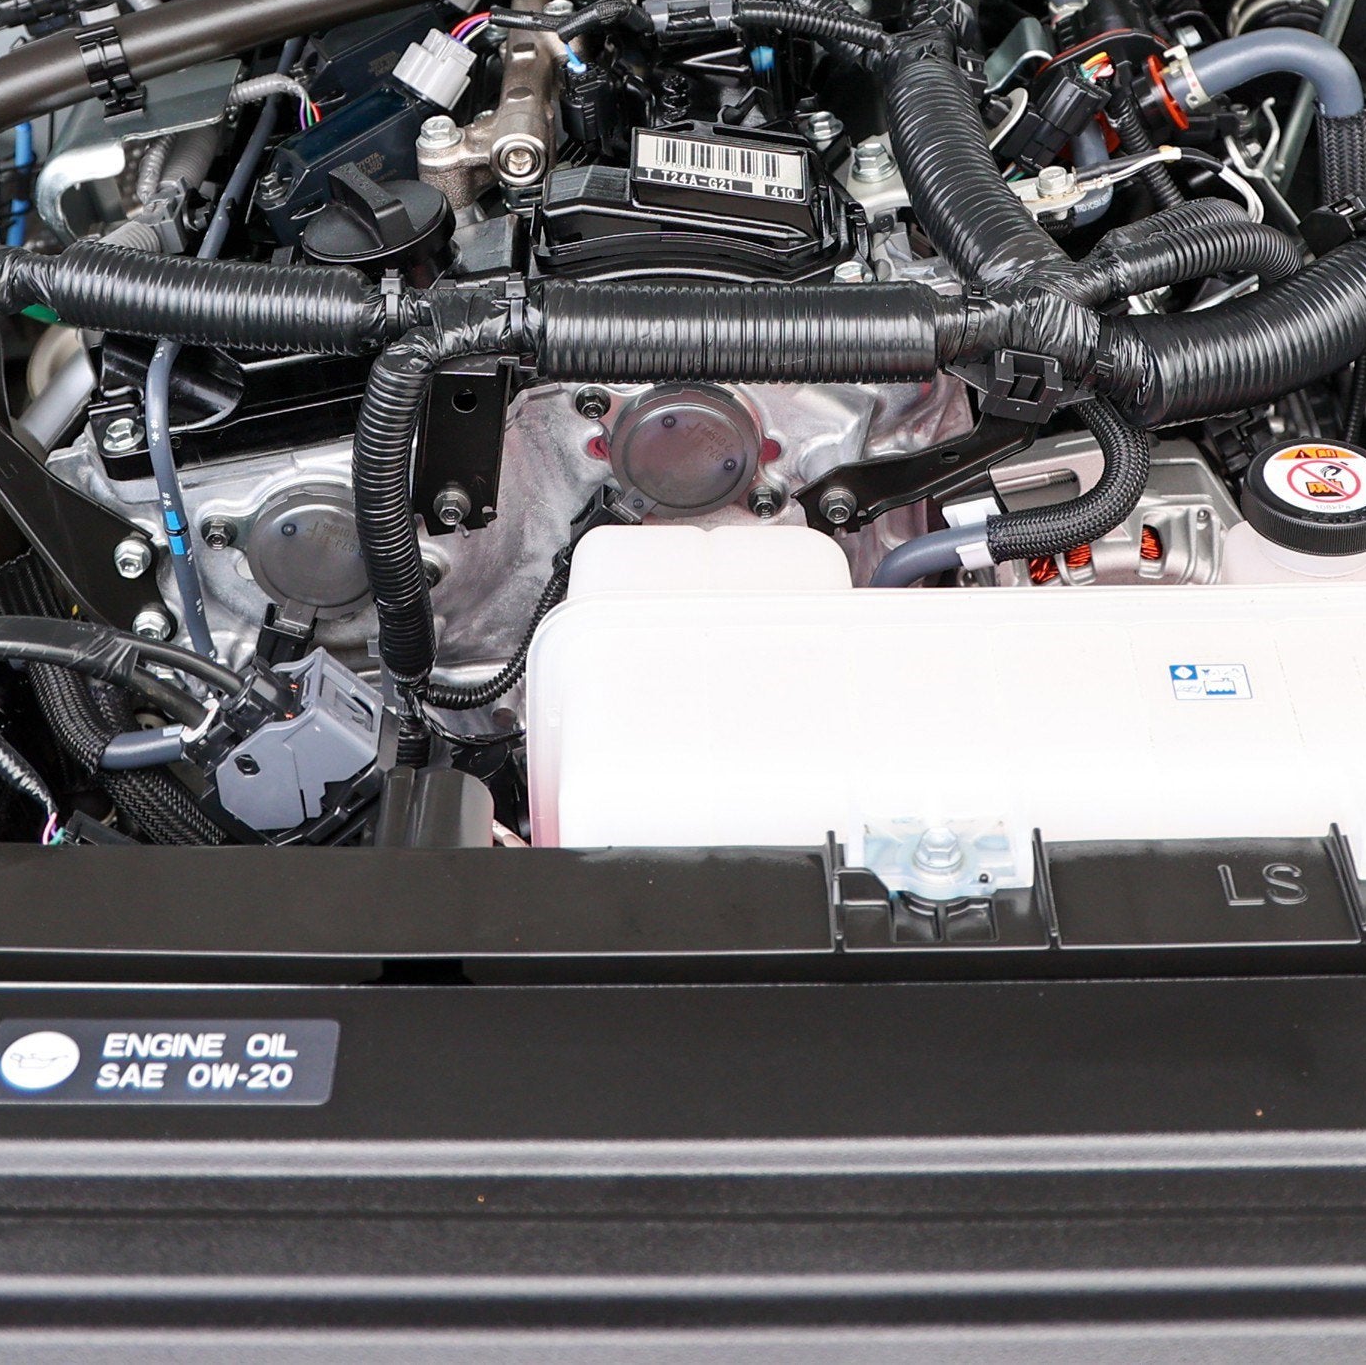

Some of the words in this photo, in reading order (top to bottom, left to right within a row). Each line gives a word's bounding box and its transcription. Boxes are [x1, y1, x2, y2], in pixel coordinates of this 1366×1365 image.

[645, 169, 654, 180] T
[661, 170, 734, 191] T24A-G21
[771, 188, 795, 200] 410
[1217, 862, 1309, 906] LS
[102, 1032, 227, 1058] ENGINE
[246, 1033, 298, 1058] OIL
[96, 1062, 168, 1089] SAE
[187, 1062, 294, 1089] 0W-20
